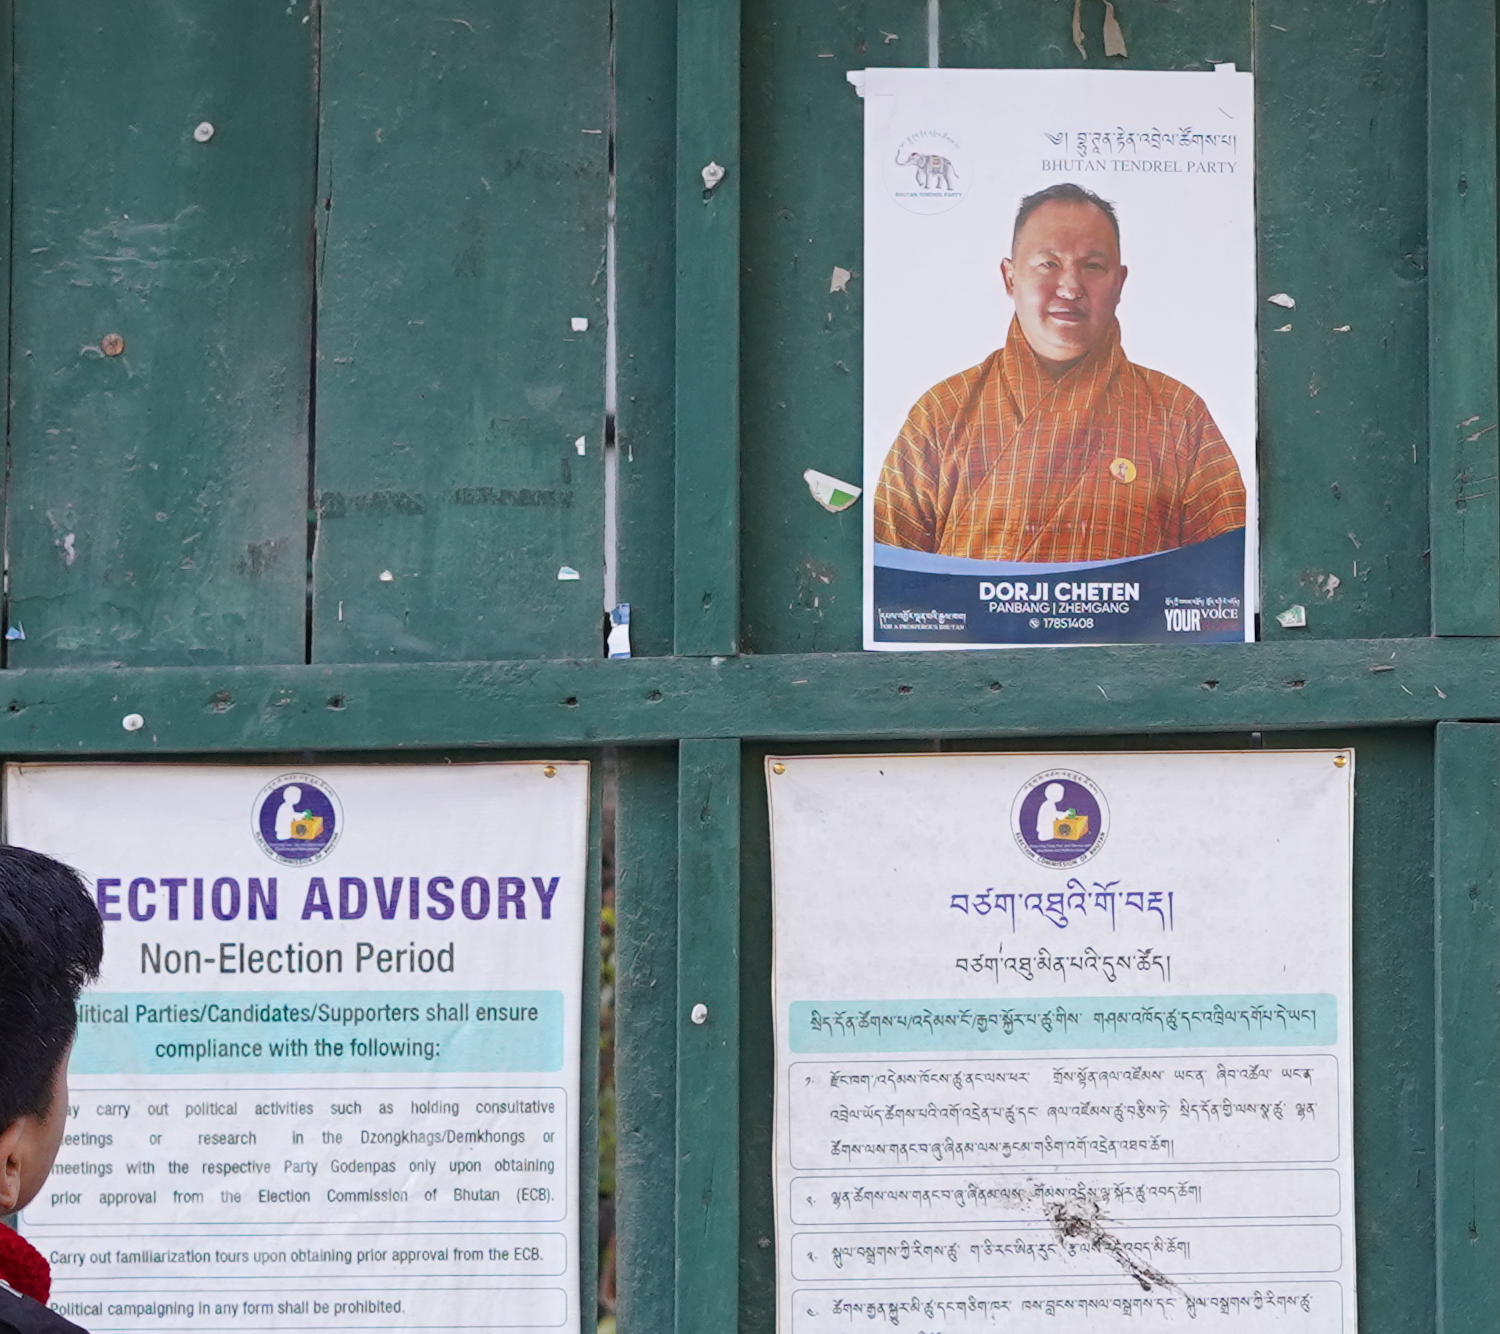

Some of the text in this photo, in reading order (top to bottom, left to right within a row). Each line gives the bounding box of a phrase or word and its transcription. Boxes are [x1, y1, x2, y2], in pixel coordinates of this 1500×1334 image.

[1041, 159, 1237, 173] BHUTAN TENDREL PARTY
[979, 582, 1140, 601] DORJI CHETEN
[988, 602, 1050, 614] PANBANG
[1058, 602, 1130, 614] ZHEMGANG
[1043, 618, 1094, 629] 17851408
[1164, 609, 1201, 632] YOUR
[96, 875, 560, 923] ECTION ADVISORY
[140, 940, 454, 974] Non-Election Period
[78, 1002, 538, 1027] litical Parties/Candidates/Supporters shall ensure
[154, 1037, 440, 1062] compliance with the following:
[50, 1246, 543, 1269] Carry out familiarization tours upon obtaining prior approval from the ECB.
